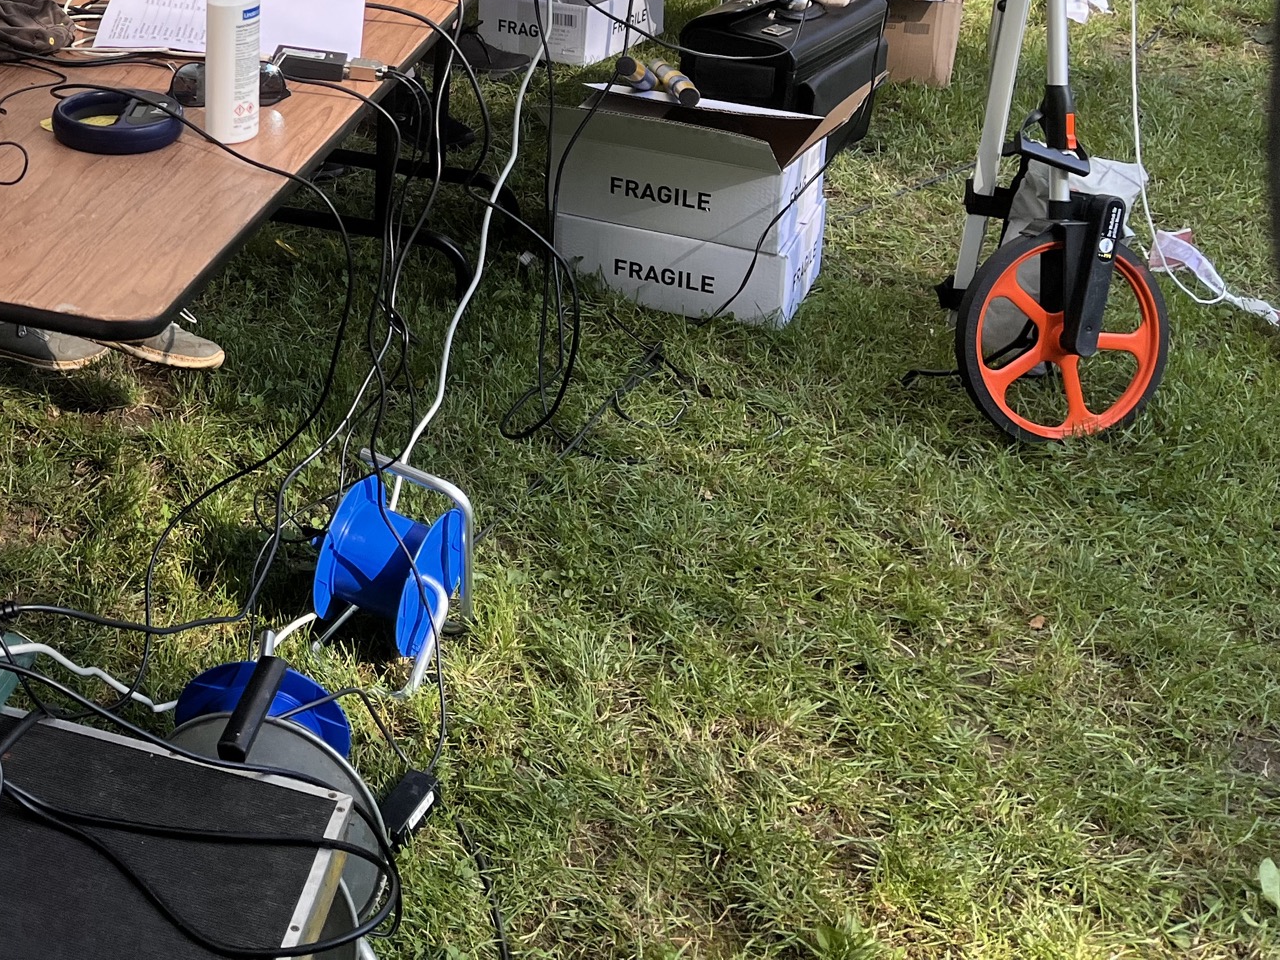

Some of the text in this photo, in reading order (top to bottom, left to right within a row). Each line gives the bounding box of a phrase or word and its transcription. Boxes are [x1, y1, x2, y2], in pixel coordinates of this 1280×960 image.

[498, 19, 539, 38] FRAG
[610, 176, 712, 212] FRAGILE
[614, 258, 715, 294] FRAGILE
